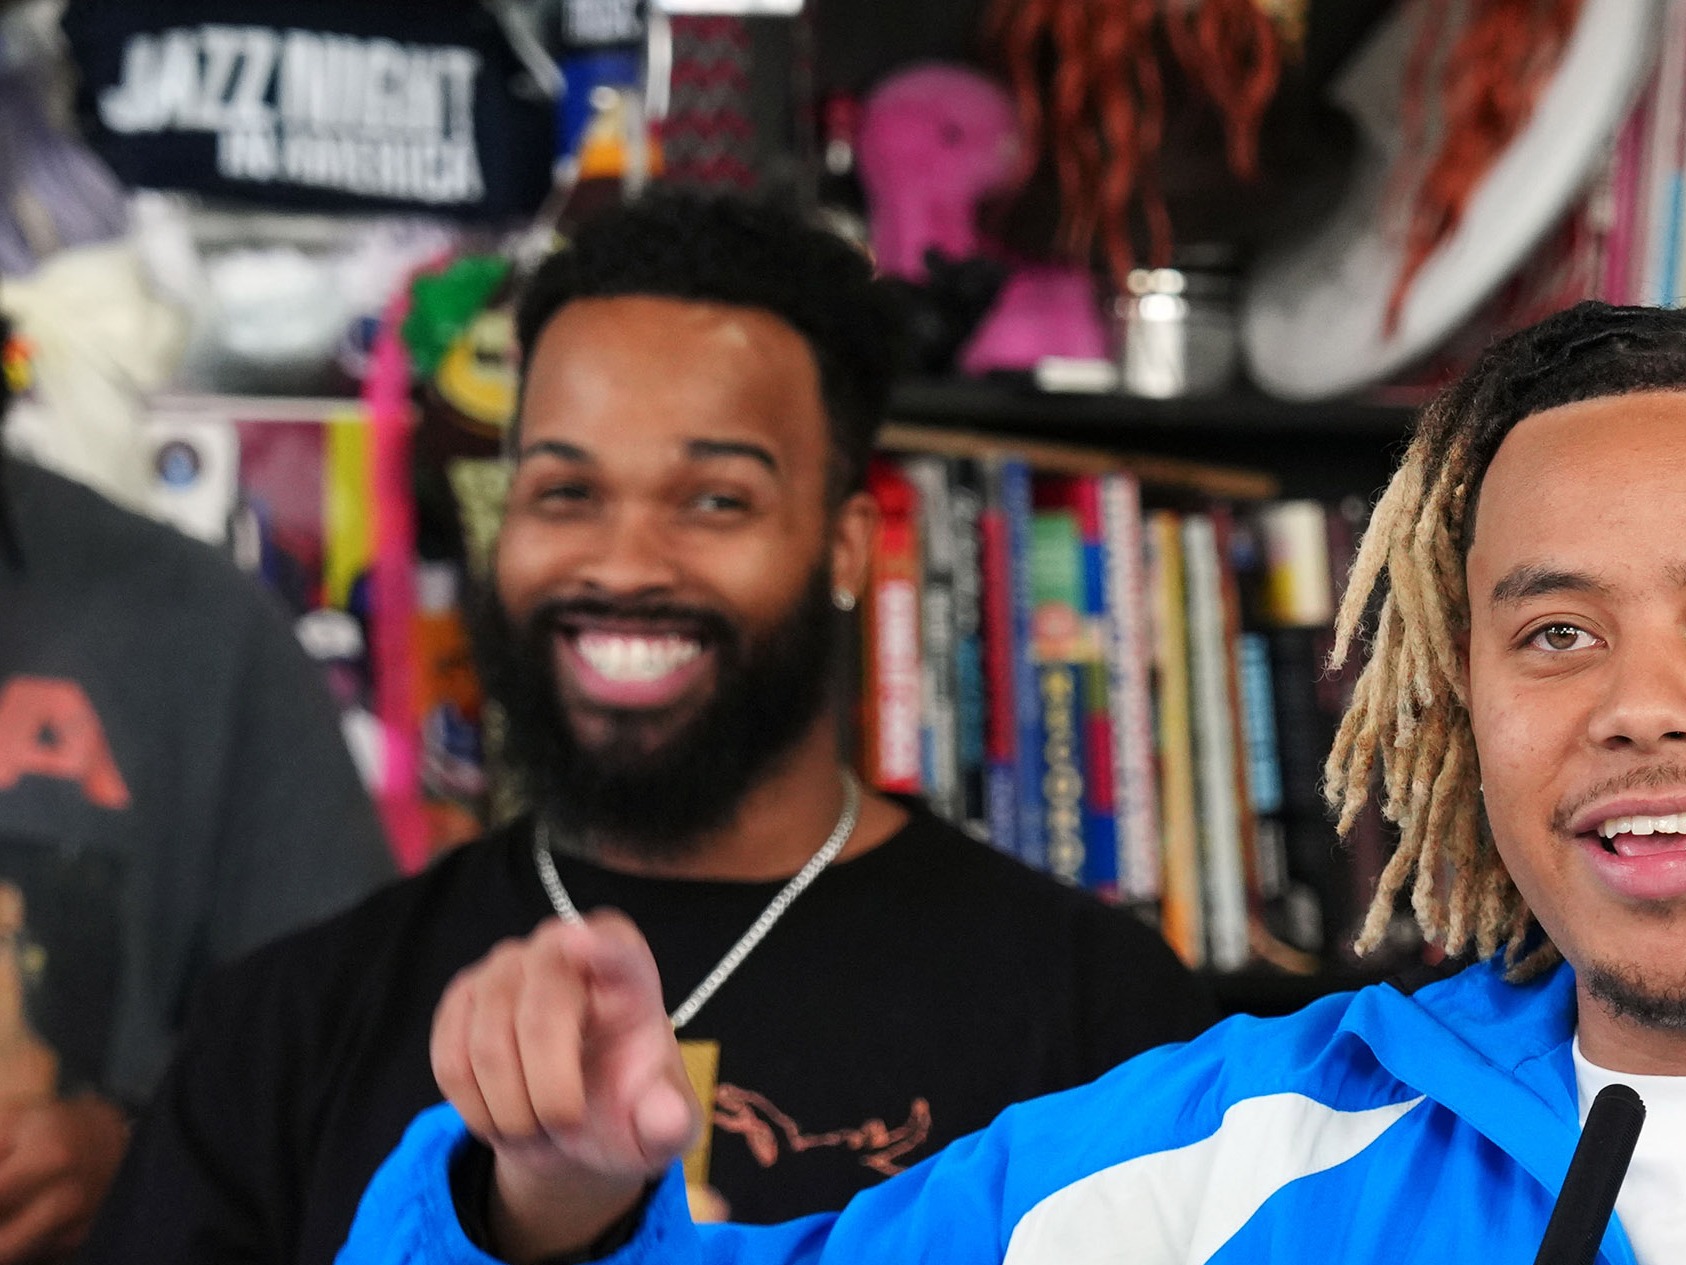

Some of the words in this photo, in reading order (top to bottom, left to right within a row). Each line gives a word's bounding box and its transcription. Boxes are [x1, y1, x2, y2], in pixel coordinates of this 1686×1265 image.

[100, 24, 280, 133] JAZZ
[282, 27, 483, 140] NIGHT
[282, 136, 486, 203] AMERICA
